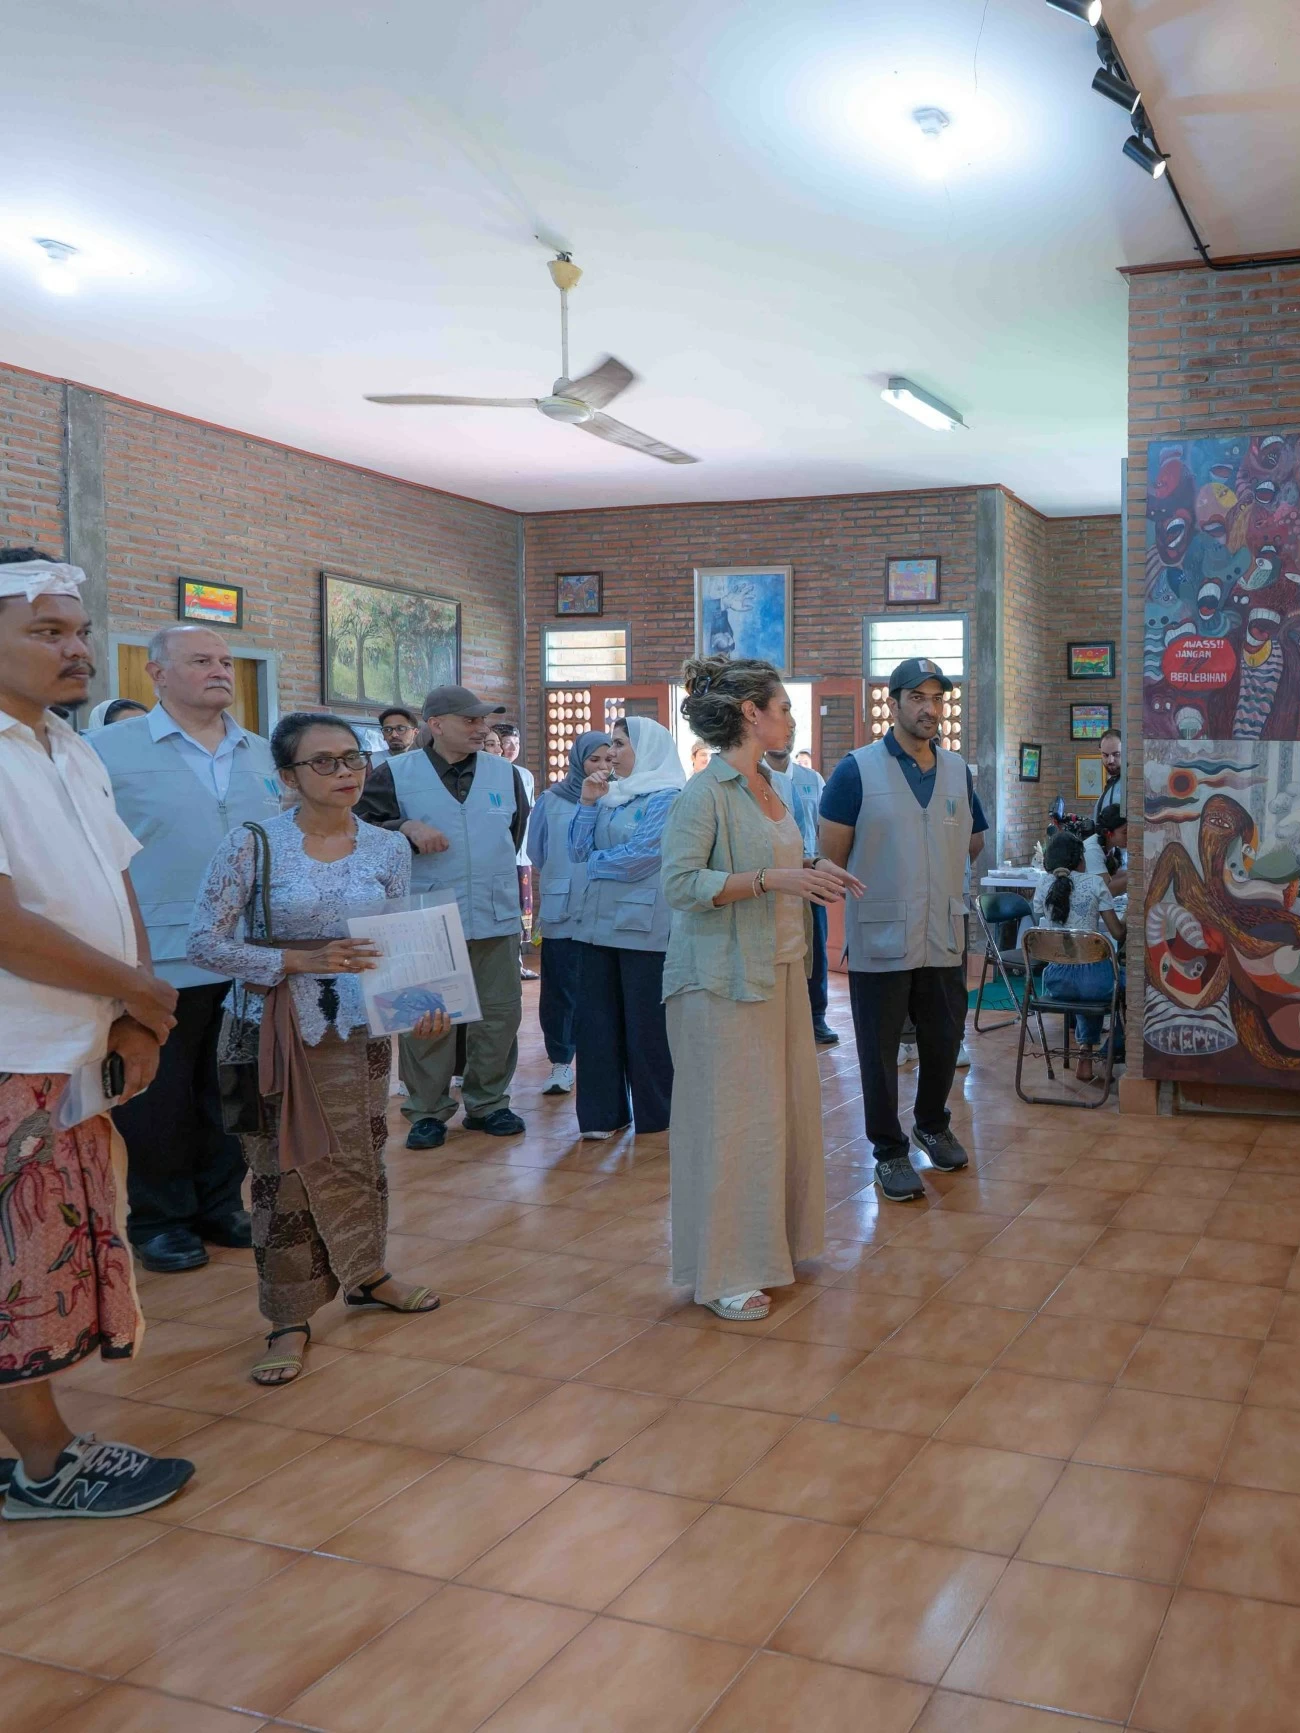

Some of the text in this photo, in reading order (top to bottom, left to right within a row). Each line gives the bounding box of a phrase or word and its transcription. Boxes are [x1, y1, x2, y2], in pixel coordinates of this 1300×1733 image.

[1183, 640, 1225, 649] AWASS!!
[1175, 650, 1212, 658] JANGAN
[1170, 672, 1227, 683] BERLEBIHAN
[56, 1478, 109, 1511] N
